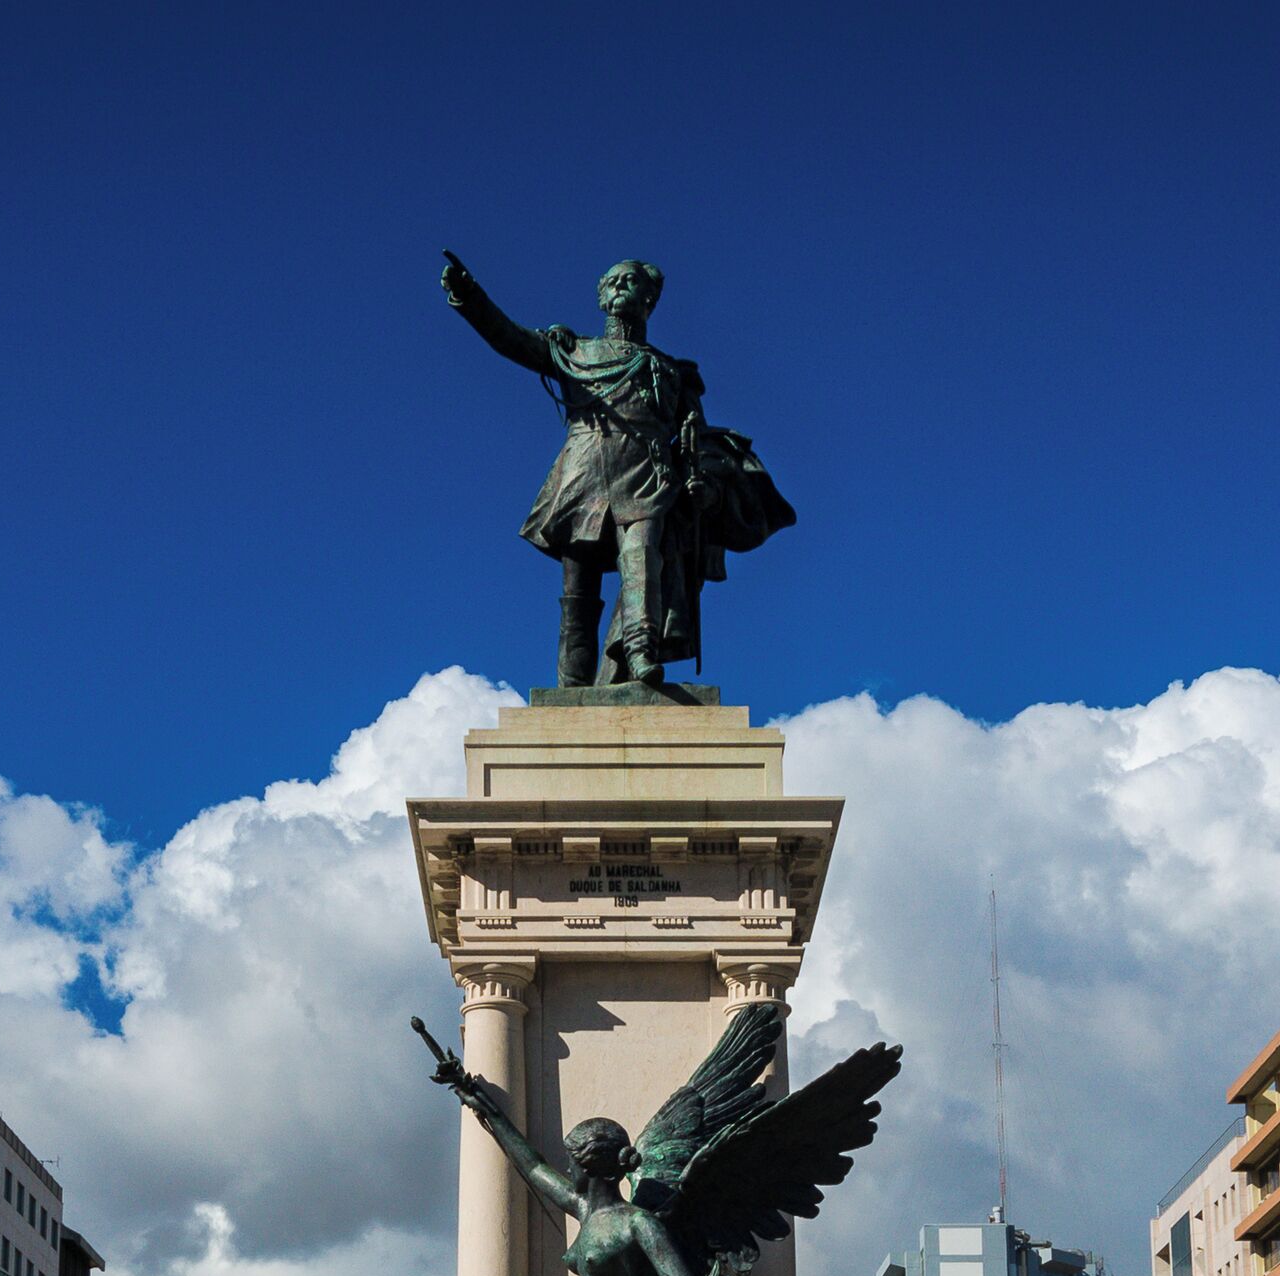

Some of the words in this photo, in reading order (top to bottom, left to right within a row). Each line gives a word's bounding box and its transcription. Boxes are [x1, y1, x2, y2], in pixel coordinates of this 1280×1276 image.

[588, 865, 601, 877] AO
[606, 865, 663, 878] MARECHAL
[569, 880, 603, 893] DUQUE
[608, 881, 622, 892] DE
[627, 881, 682, 892] SALDANHA
